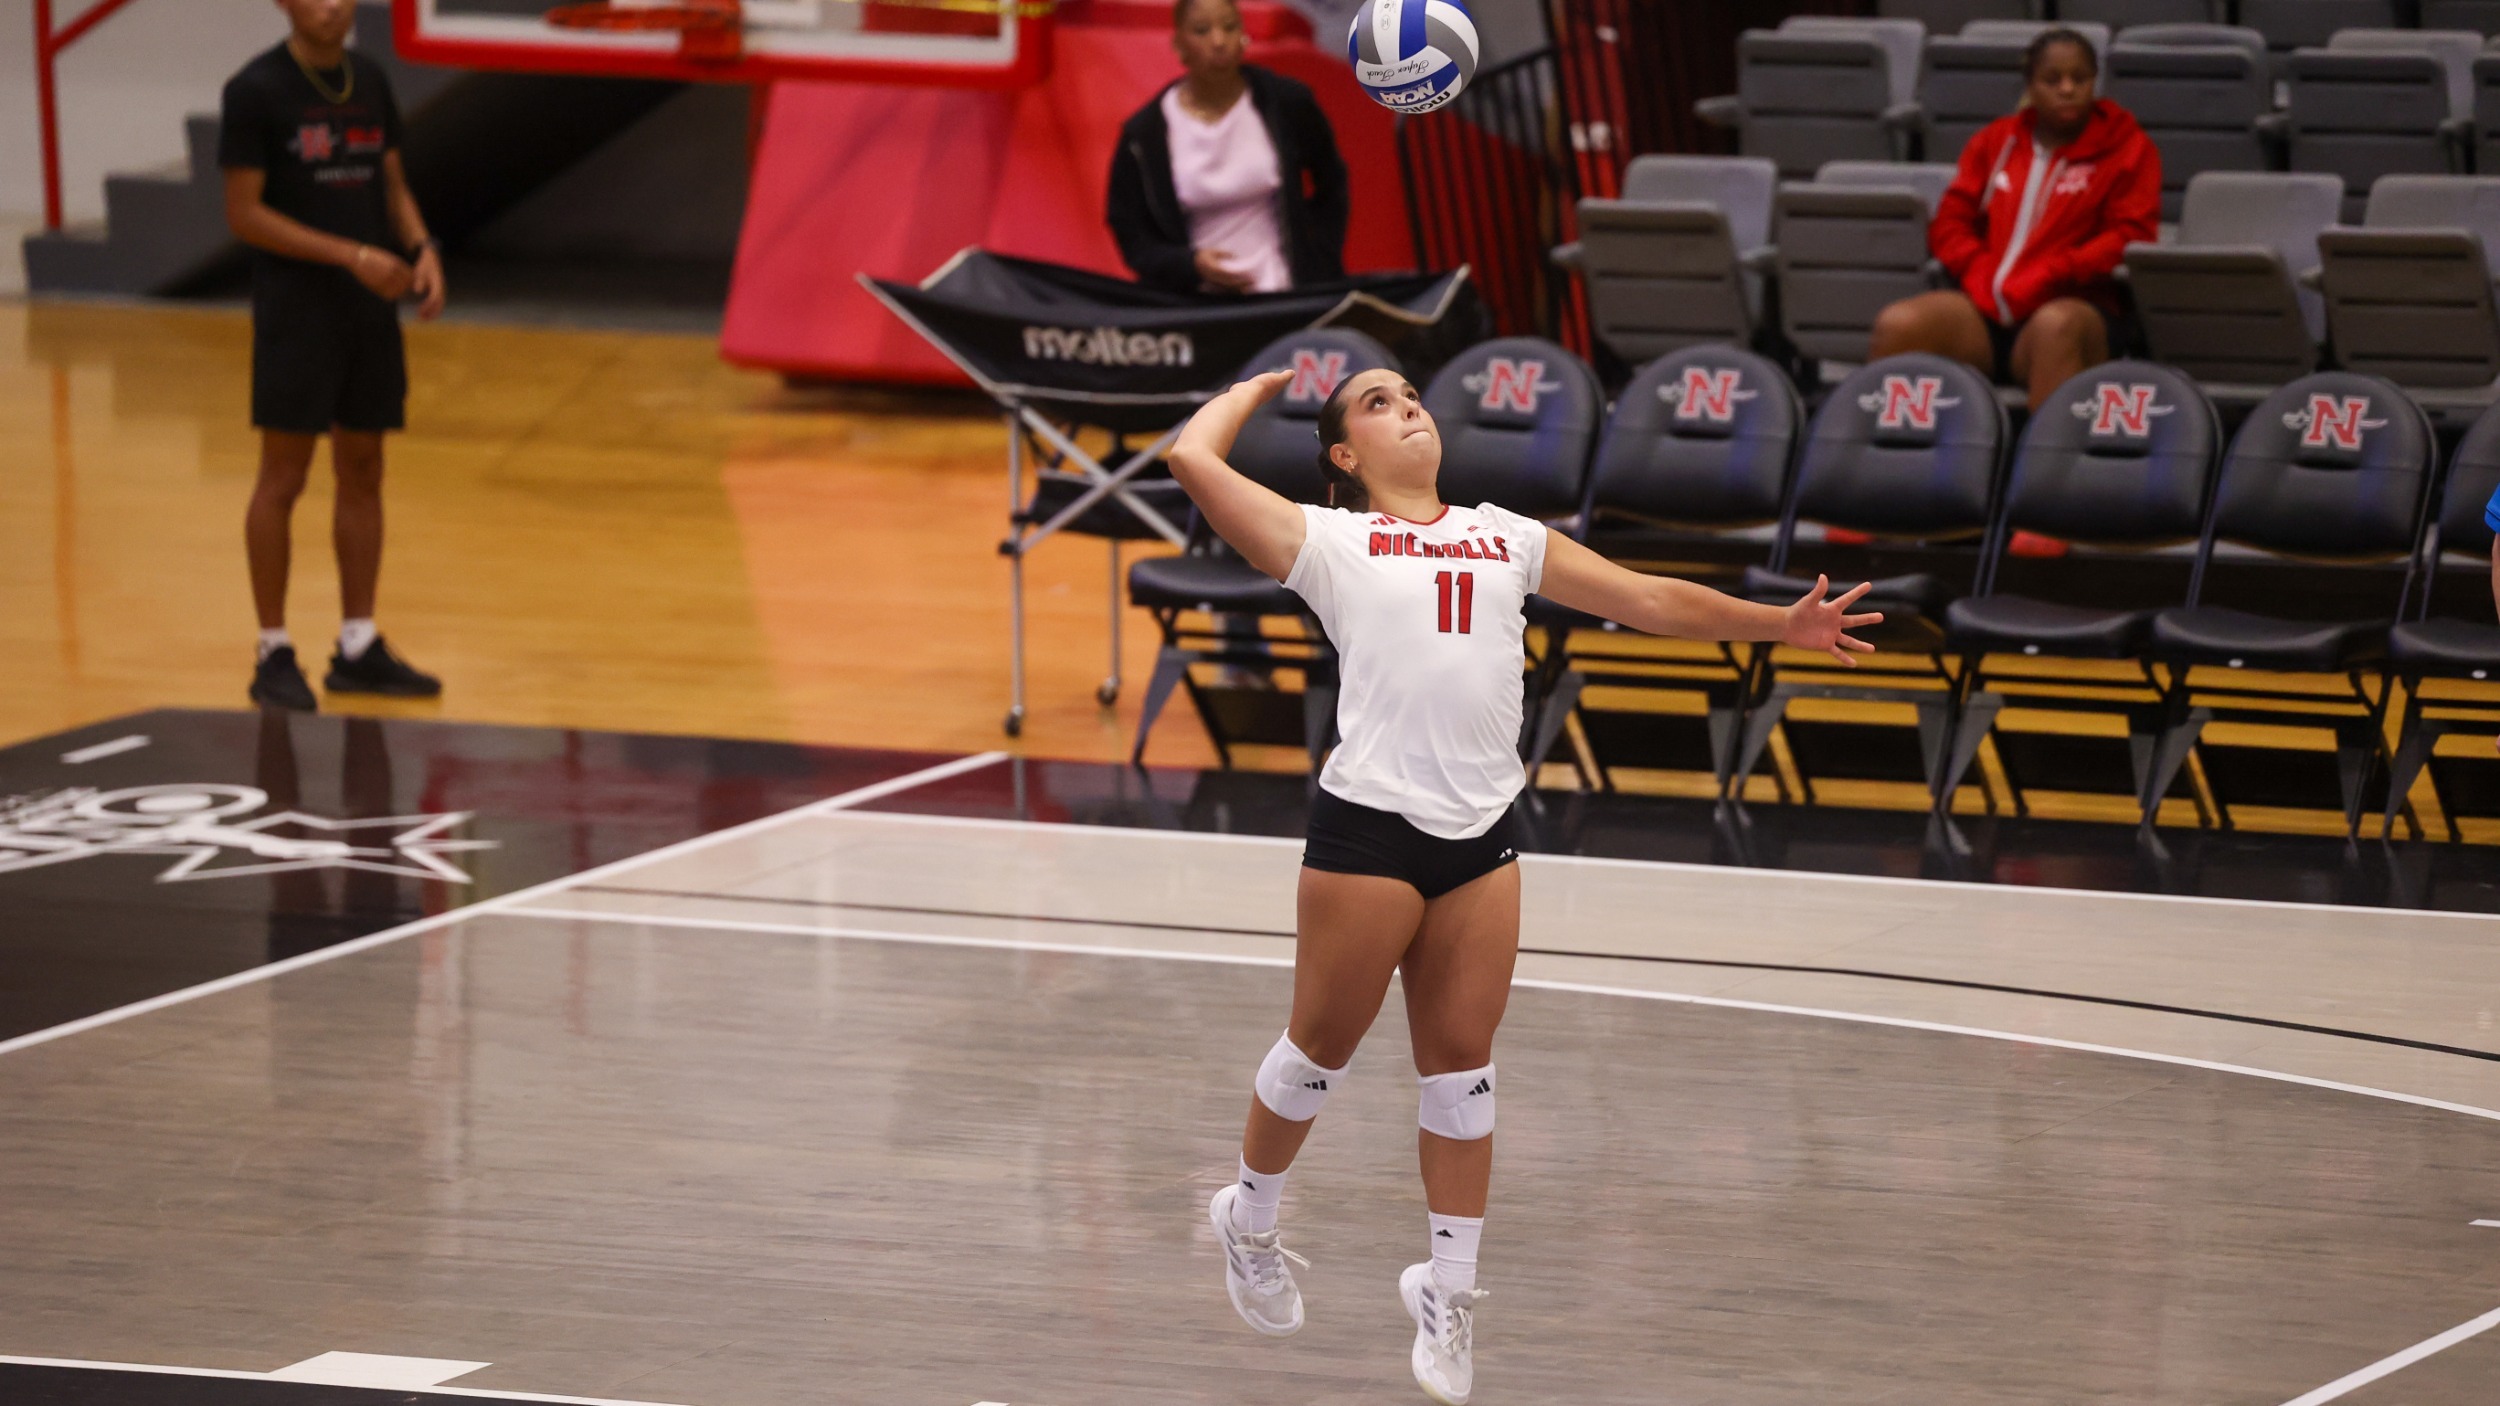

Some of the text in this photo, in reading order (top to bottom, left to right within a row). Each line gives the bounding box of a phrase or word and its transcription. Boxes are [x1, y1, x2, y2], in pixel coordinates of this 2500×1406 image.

[1366, 69, 1395, 82] Touch
[1379, 80, 1436, 104] NCAA
[1390, 91, 1451, 113] molte
[1022, 326, 1194, 368] molten
[1287, 350, 1347, 402] N
[1481, 358, 1546, 414] N
[1674, 365, 1741, 422] N
[1878, 374, 1942, 429] N
[2090, 383, 2156, 436] N
[2301, 392, 2370, 450] N
[1369, 531, 1510, 563] NICHOLLS
[1434, 571, 1474, 635] 11
